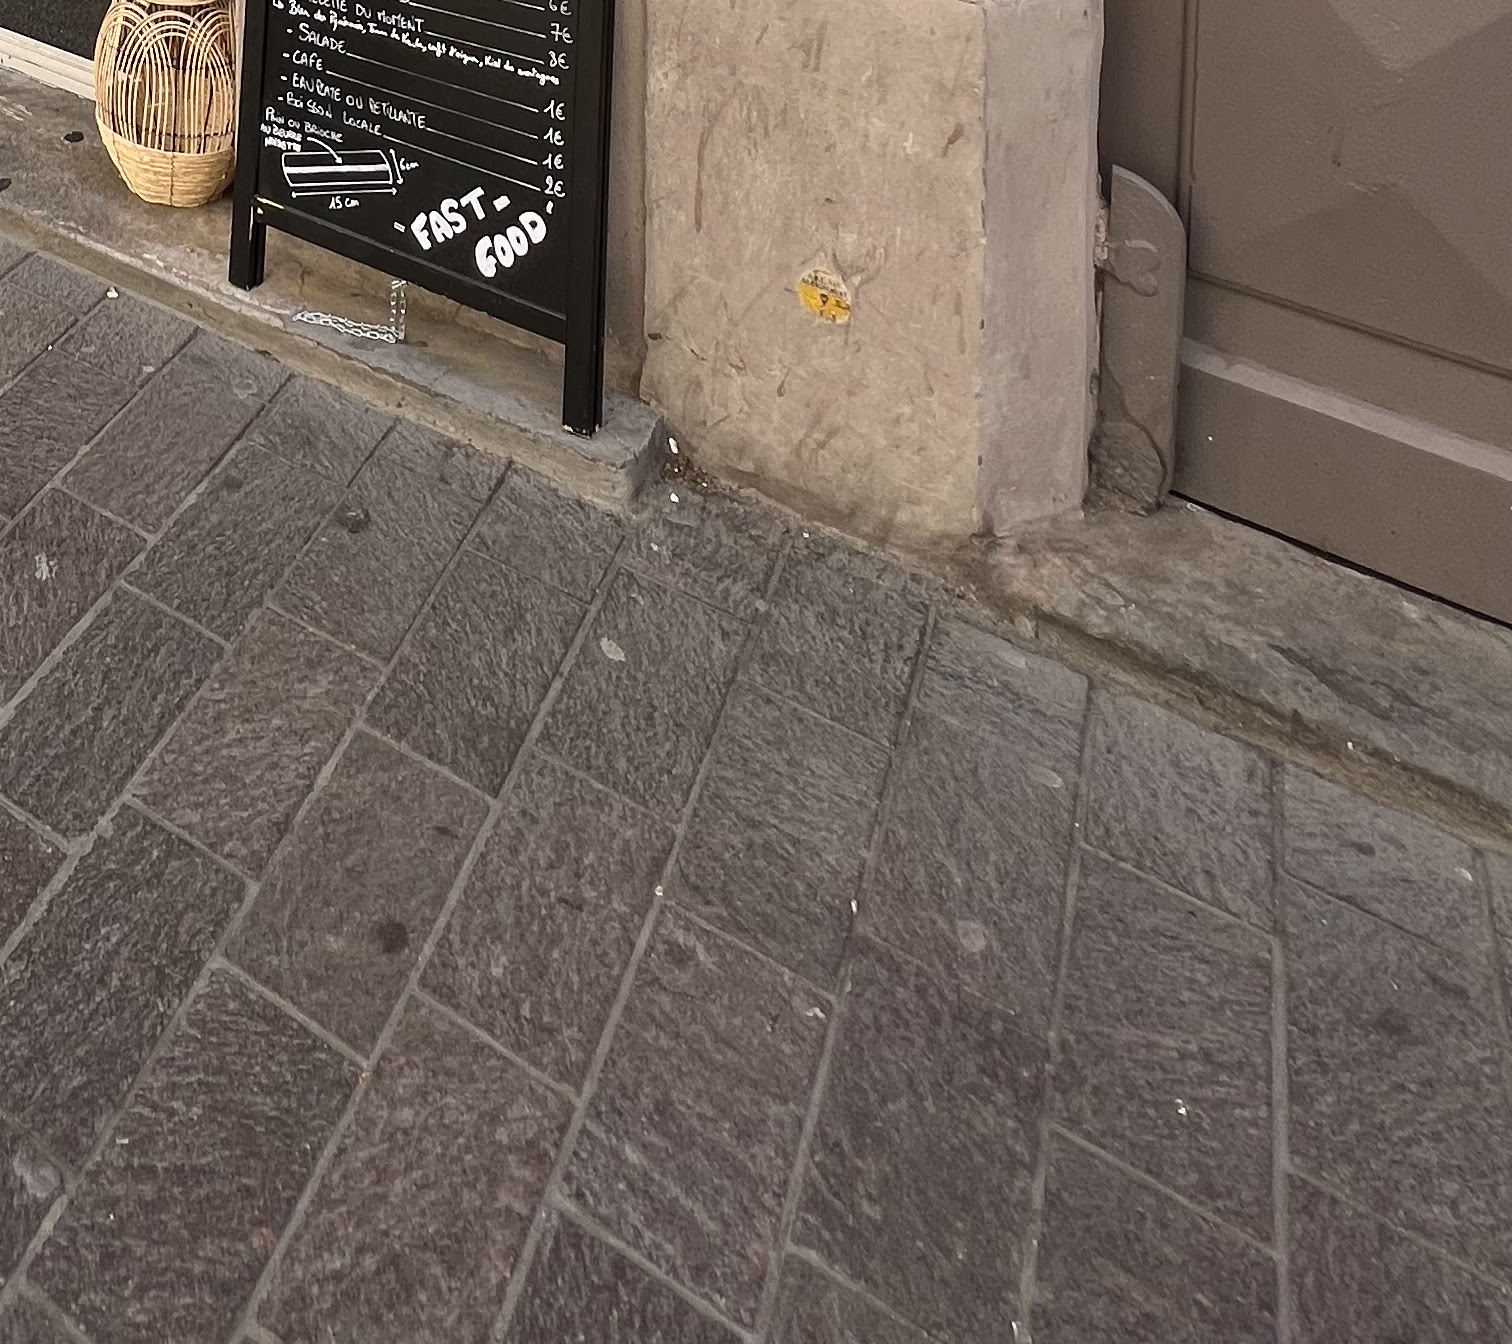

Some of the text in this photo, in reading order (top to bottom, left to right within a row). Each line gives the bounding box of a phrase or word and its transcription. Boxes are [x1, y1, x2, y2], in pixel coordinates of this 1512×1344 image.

[355, 3, 372, 19] DU
[376, 10, 425, 33] MOMENT
[550, 22, 575, 44] 7€
[298, 22, 567, 121] SALADE 1€
[345, 95, 364, 110] OU
[542, 154, 565, 172] 1€
[543, 126, 565, 147] 1€
[543, 176, 566, 199] 2€
